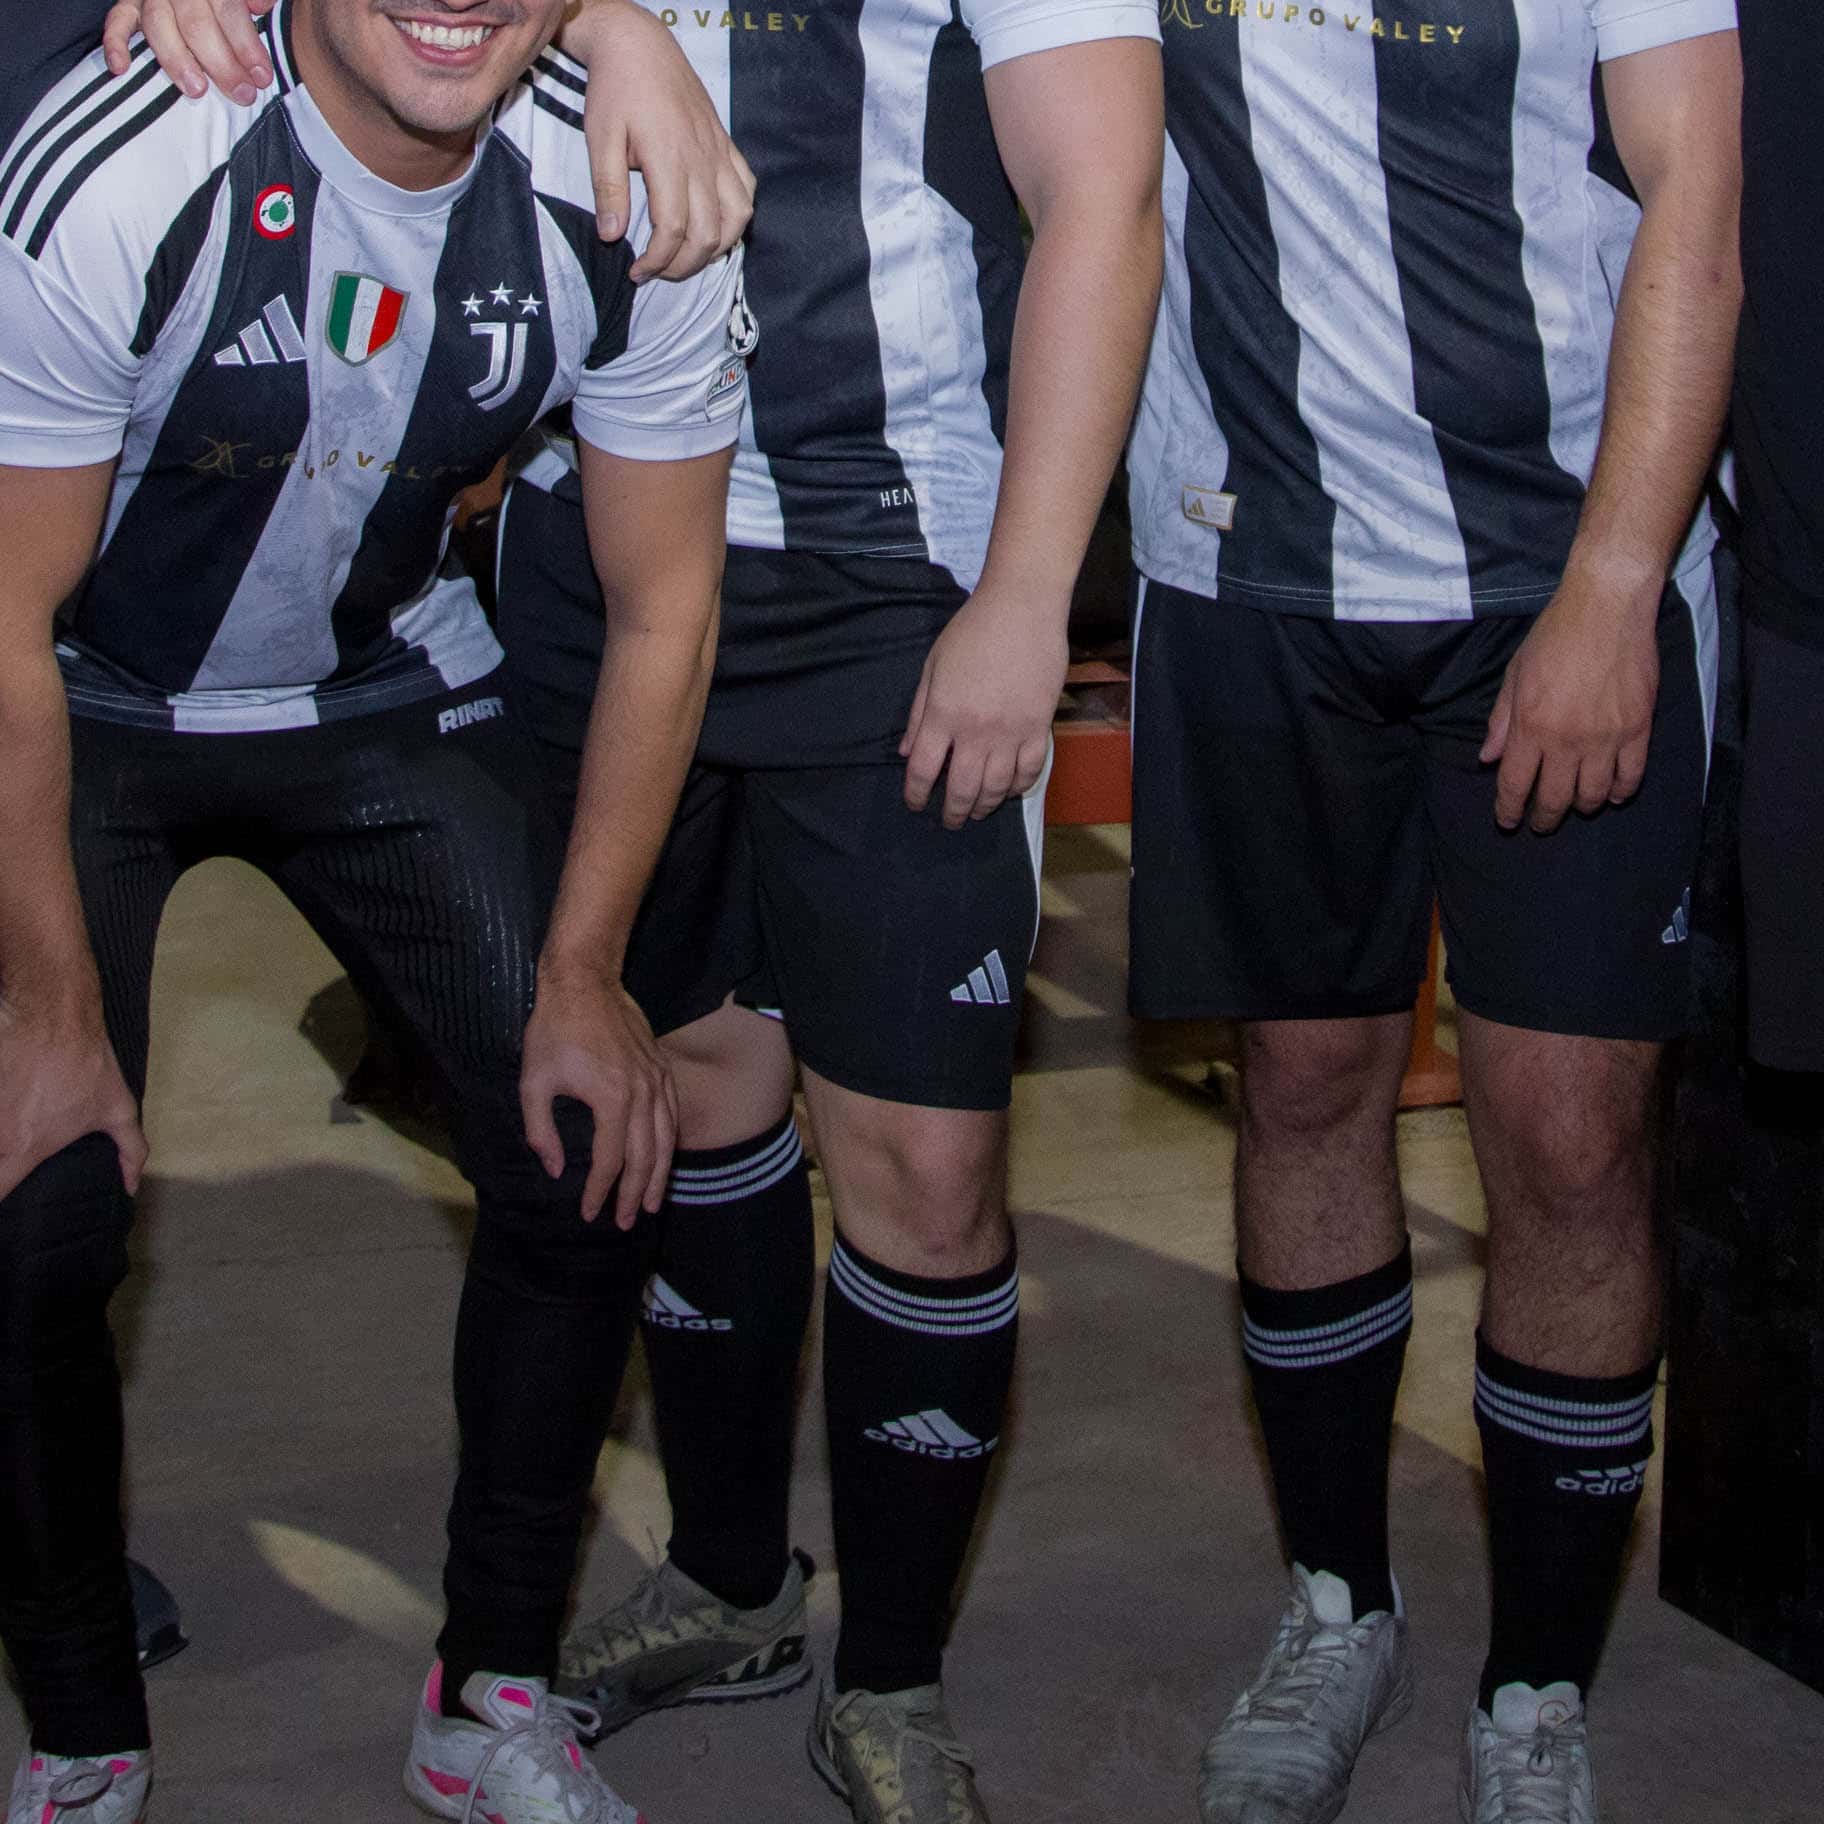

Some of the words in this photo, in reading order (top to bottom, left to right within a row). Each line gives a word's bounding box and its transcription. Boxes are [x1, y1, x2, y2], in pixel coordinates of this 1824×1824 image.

[693, 9, 810, 33] VALEY
[1344, 14, 1465, 44] VALEY
[863, 1427, 999, 1459] adidas
[1555, 1474, 1644, 1496] adid
